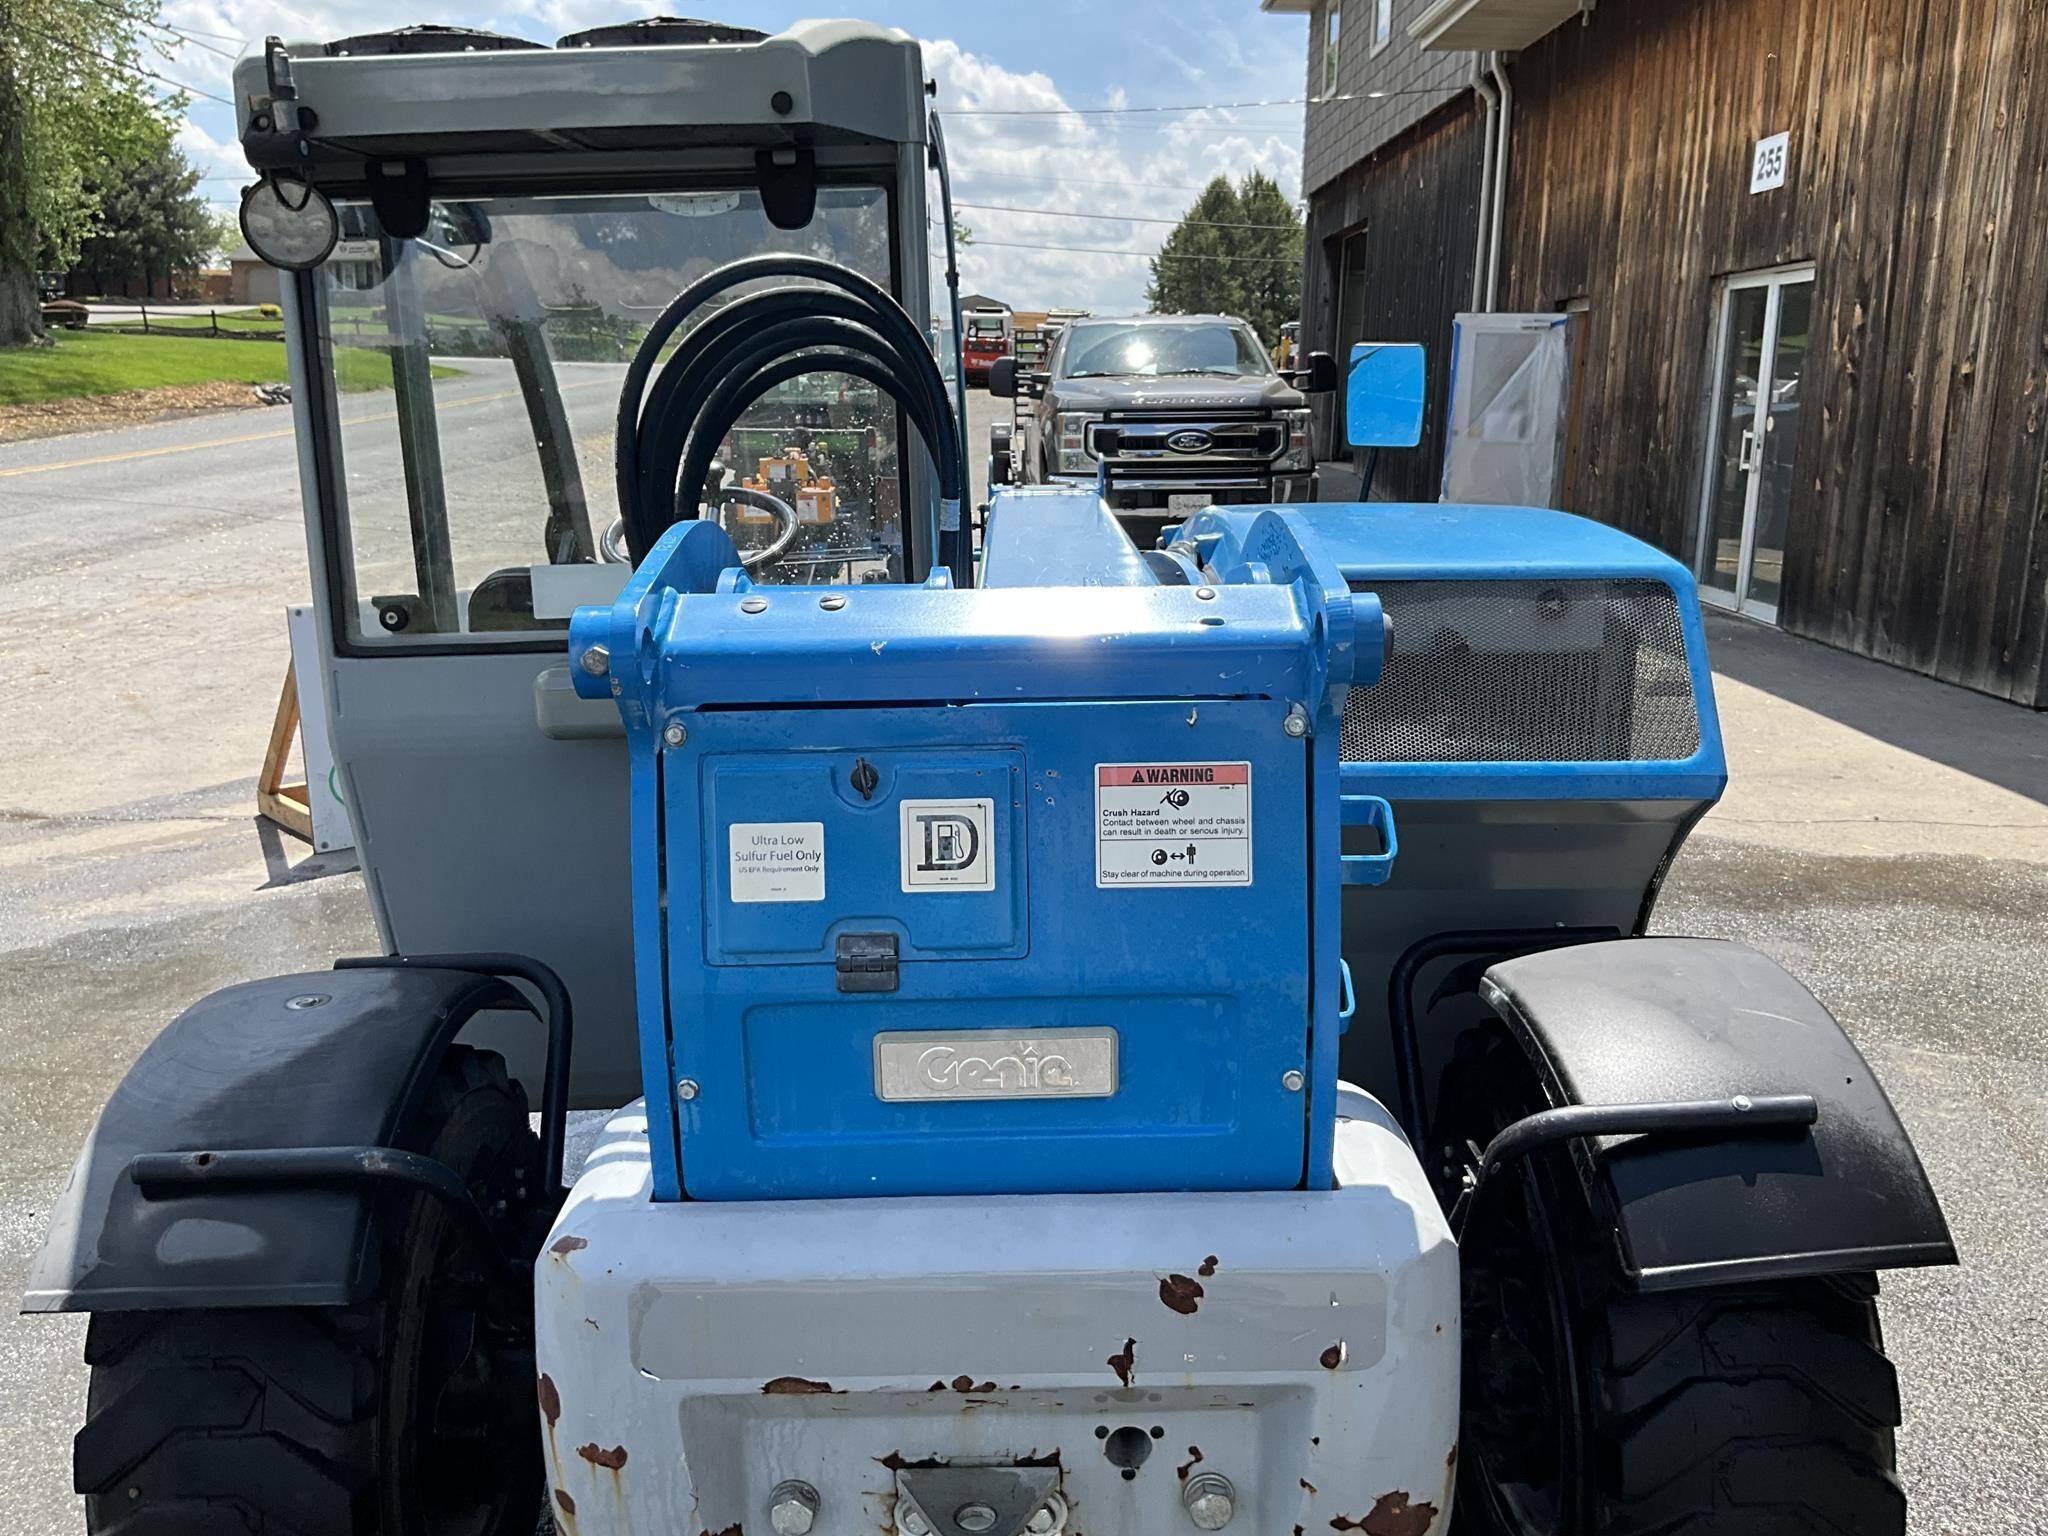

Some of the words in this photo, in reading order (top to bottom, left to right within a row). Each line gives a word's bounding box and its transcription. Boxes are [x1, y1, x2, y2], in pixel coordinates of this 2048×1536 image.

[1756, 145, 1783, 181] 255
[1179, 436, 1201, 447] Ford
[1146, 767, 1214, 783] WARNING
[1102, 809, 1128, 817] Crush
[1130, 808, 1160, 816] Hazard
[1102, 818, 1133, 826] Contact
[1135, 818, 1170, 826] between
[1172, 817, 1195, 825] wheel
[1198, 817, 1213, 825] and
[1215, 817, 1246, 825] chassis
[1119, 828, 1142, 836] result
[1154, 828, 1177, 836] death
[1221, 826, 1245, 836] injury.
[751, 835, 778, 846] Ultra
[781, 835, 804, 845] Low
[916, 814, 979, 871] D
[735, 851, 767, 862] Sulfur
[769, 850, 793, 861] Fuel
[795, 849, 821, 862] Only
[762, 866, 803, 874] Requirement
[803, 865, 820, 873] Only
[1102, 870, 1120, 879] Stay
[1120, 870, 1140, 878] clear
[1140, 869, 1149, 877] of
[1149, 869, 1182, 877] machine
[1183, 870, 1208, 878] during
[918, 1046, 1072, 1091] Genie
